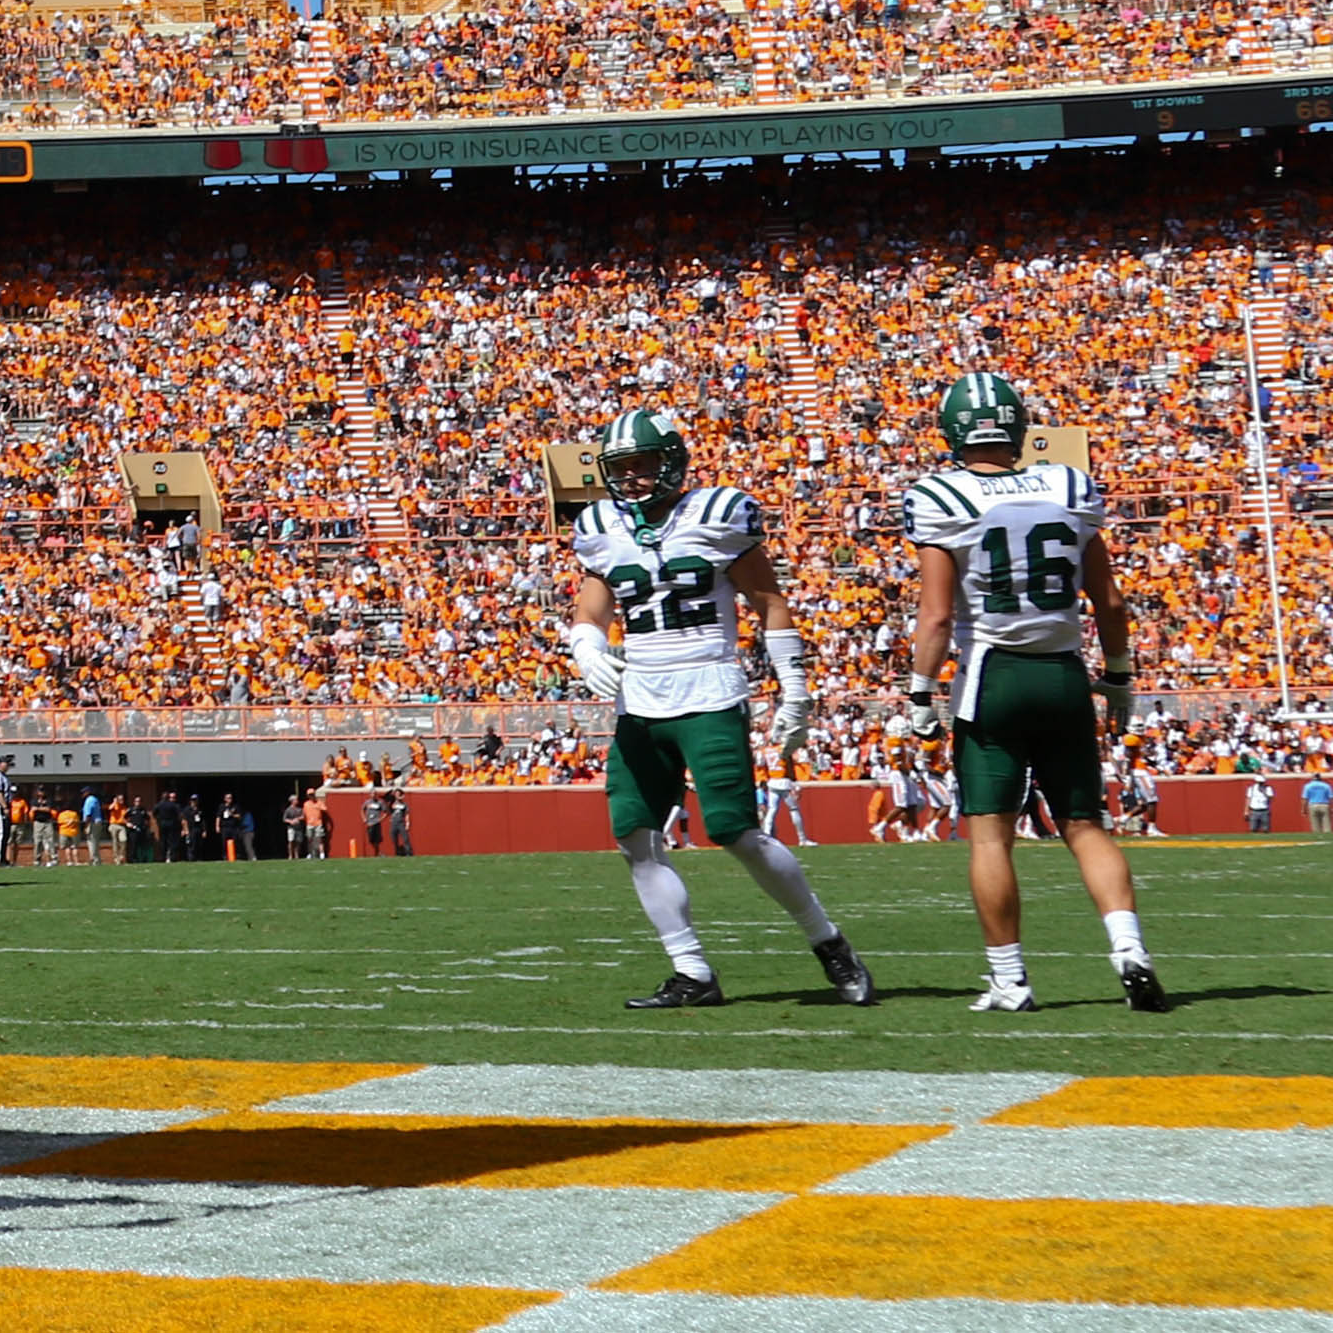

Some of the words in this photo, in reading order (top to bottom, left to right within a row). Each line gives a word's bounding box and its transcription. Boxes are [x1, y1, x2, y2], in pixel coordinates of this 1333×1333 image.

[1284, 88, 1309, 98] 3RD
[1312, 85, 1333, 96] DO
[1132, 99, 1152, 109] 1ST
[1156, 95, 1205, 107] DOWNS
[1157, 111, 1174, 130] 9
[355, 143, 376, 163] IS
[385, 140, 454, 162] YOUR
[463, 134, 613, 159] INSURANCE
[622, 128, 755, 153] COMPANY
[763, 122, 874, 146] PLAYING
[884, 118, 955, 140] YOU?
[997, 405, 1015, 424] 16
[982, 522, 1078, 613] 16
[606, 555, 718, 633] 22
